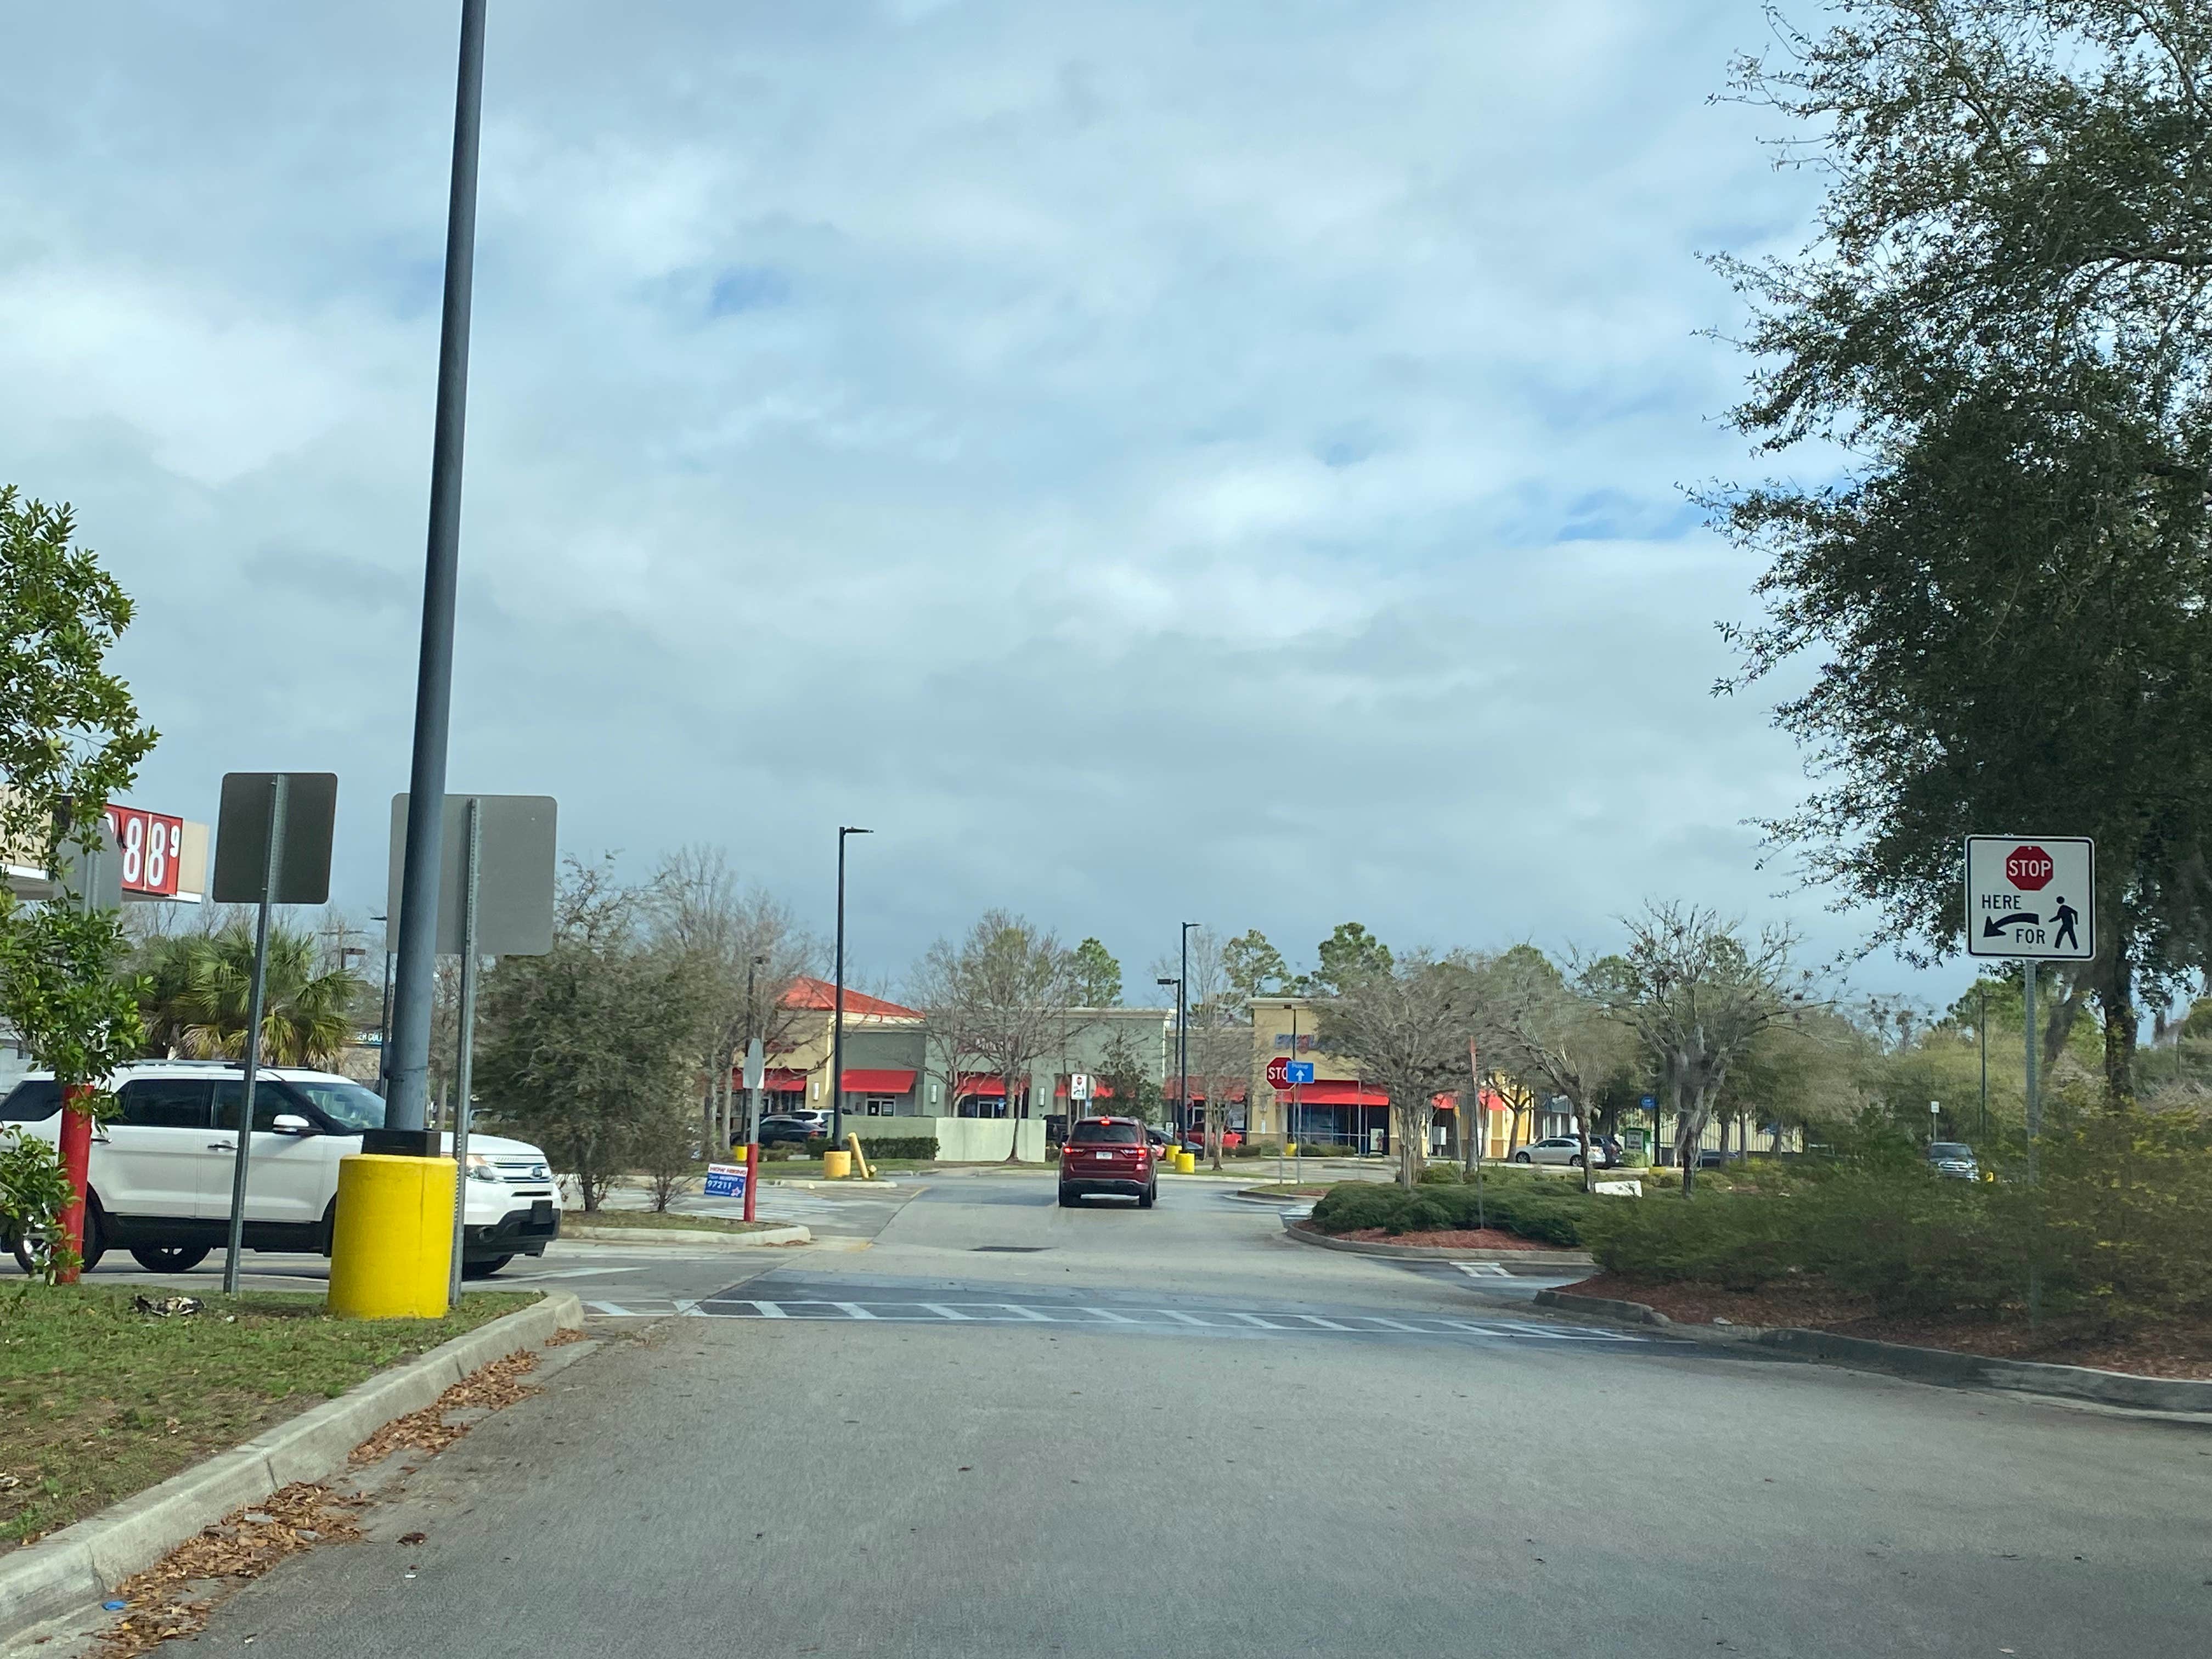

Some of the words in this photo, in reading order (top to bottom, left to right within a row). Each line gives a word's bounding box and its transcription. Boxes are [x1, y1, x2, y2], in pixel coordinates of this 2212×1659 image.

[2008, 859, 2052, 877] STOP
[1981, 894, 2022, 910] HERE
[2016, 928, 2046, 945] FOR
[1268, 1067, 1286, 1080] STO
[707, 1180, 732, 1190] 97211
